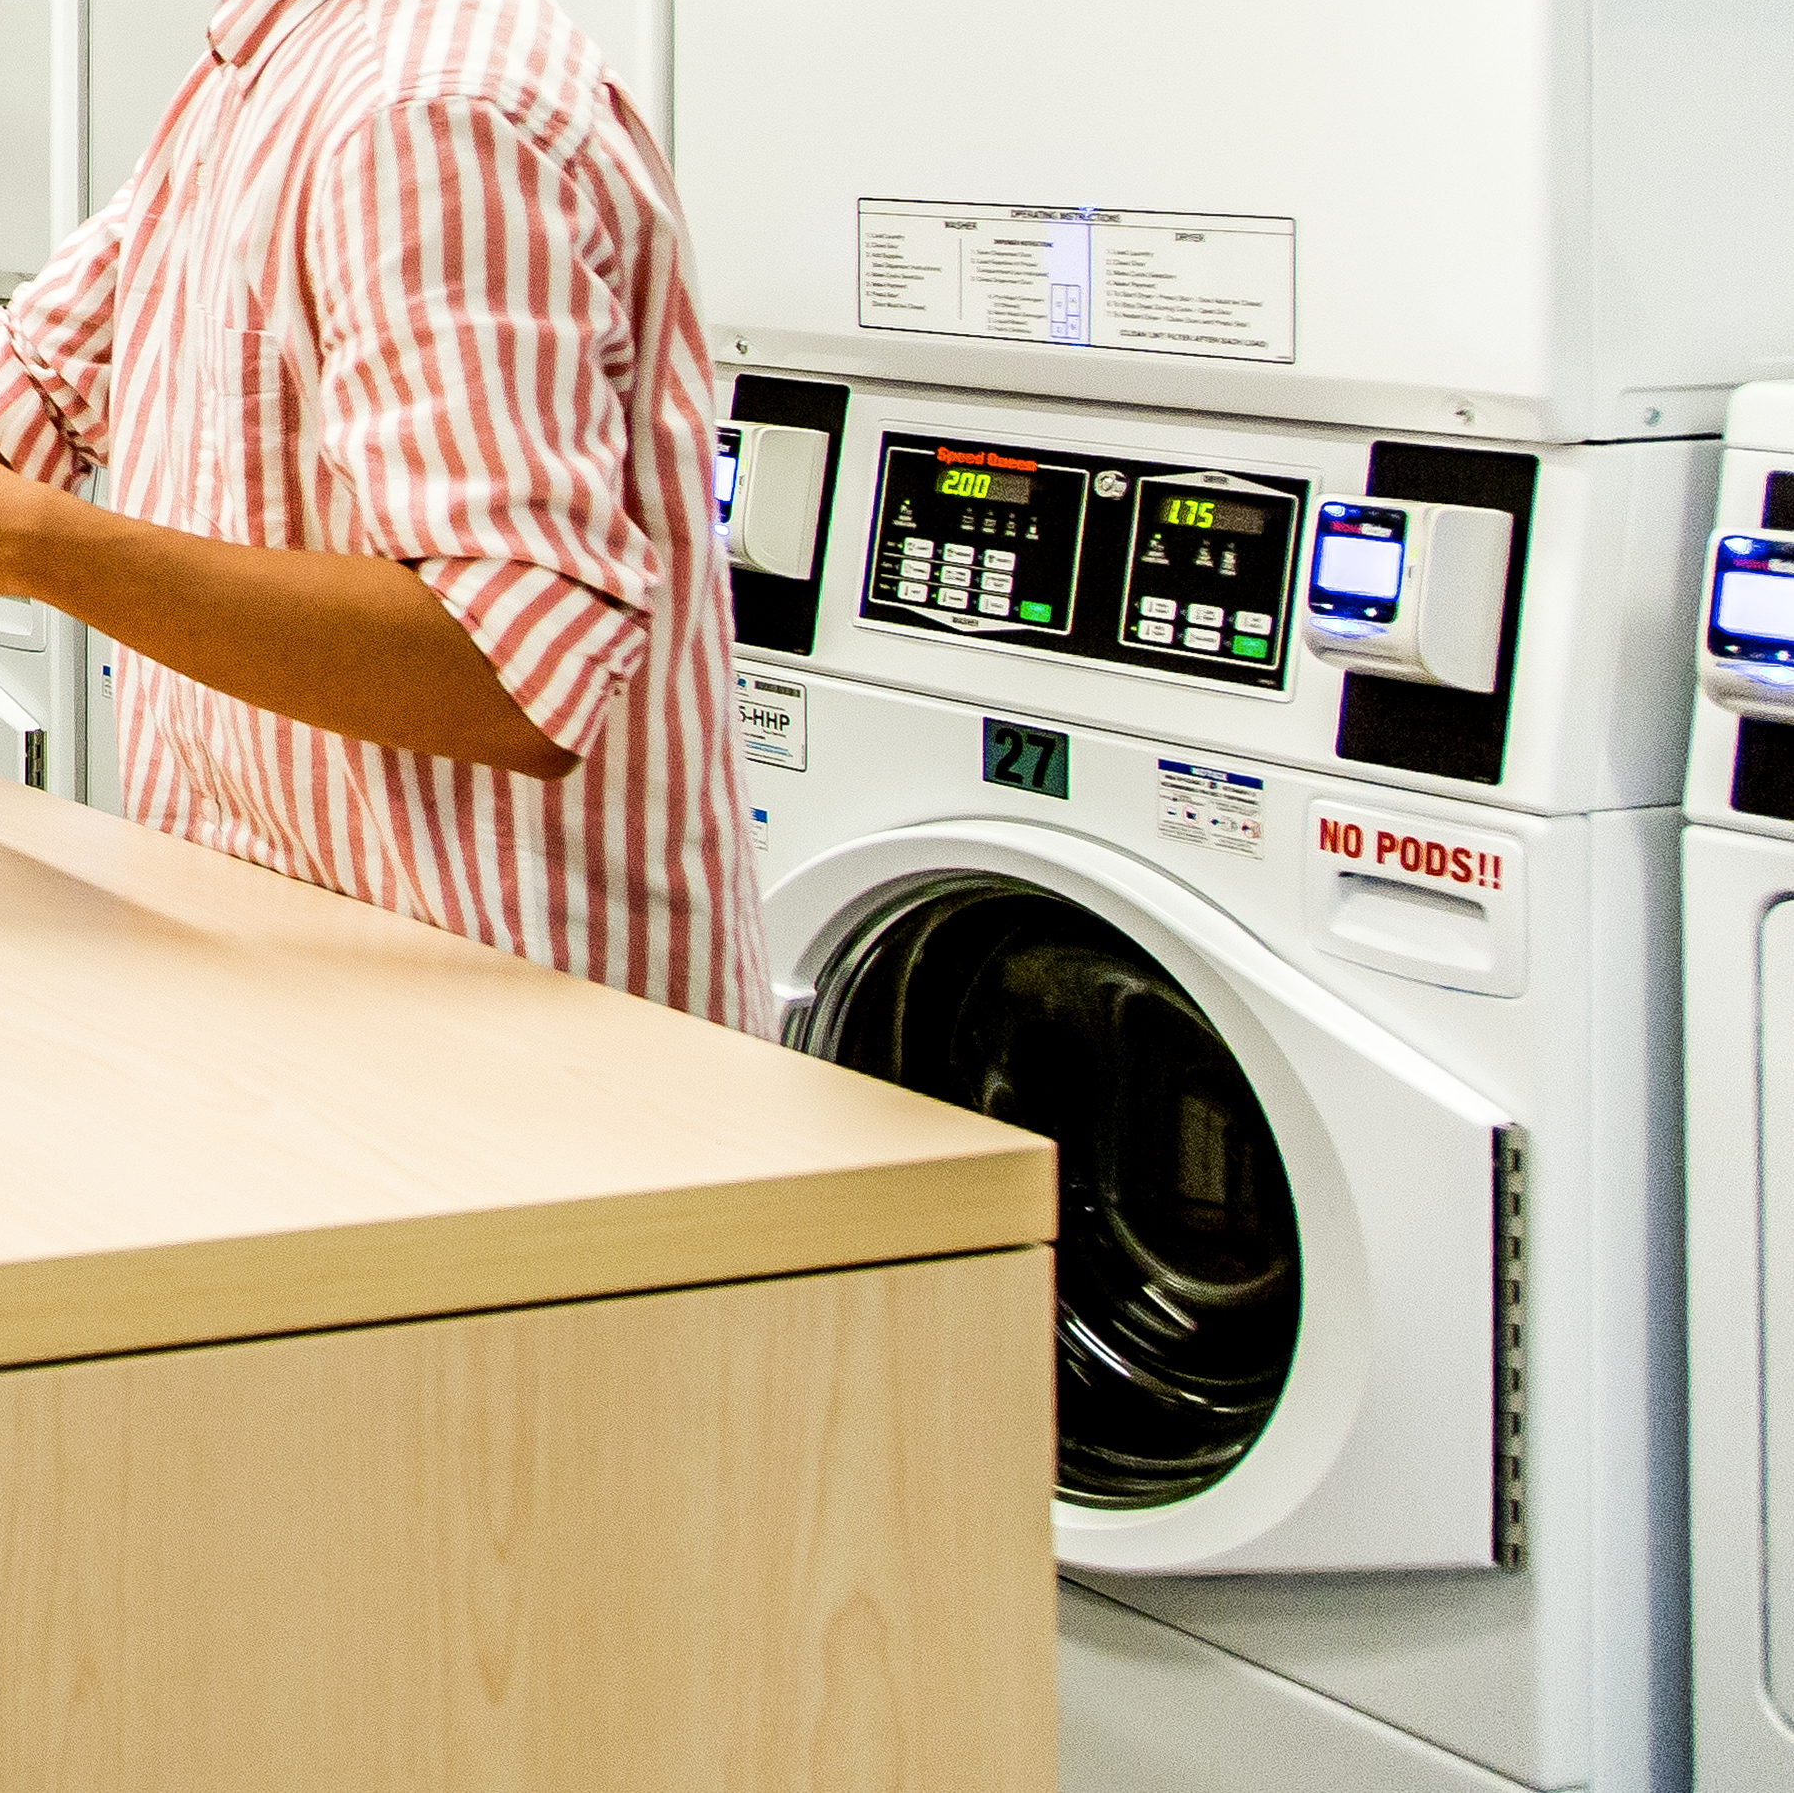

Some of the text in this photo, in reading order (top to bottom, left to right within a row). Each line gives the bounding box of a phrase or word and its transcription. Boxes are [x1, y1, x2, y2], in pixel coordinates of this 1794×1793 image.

[936, 445, 985, 465] Speed
[994, 727, 1057, 789] 27
[1319, 818, 1503, 890] NO PODS!!
